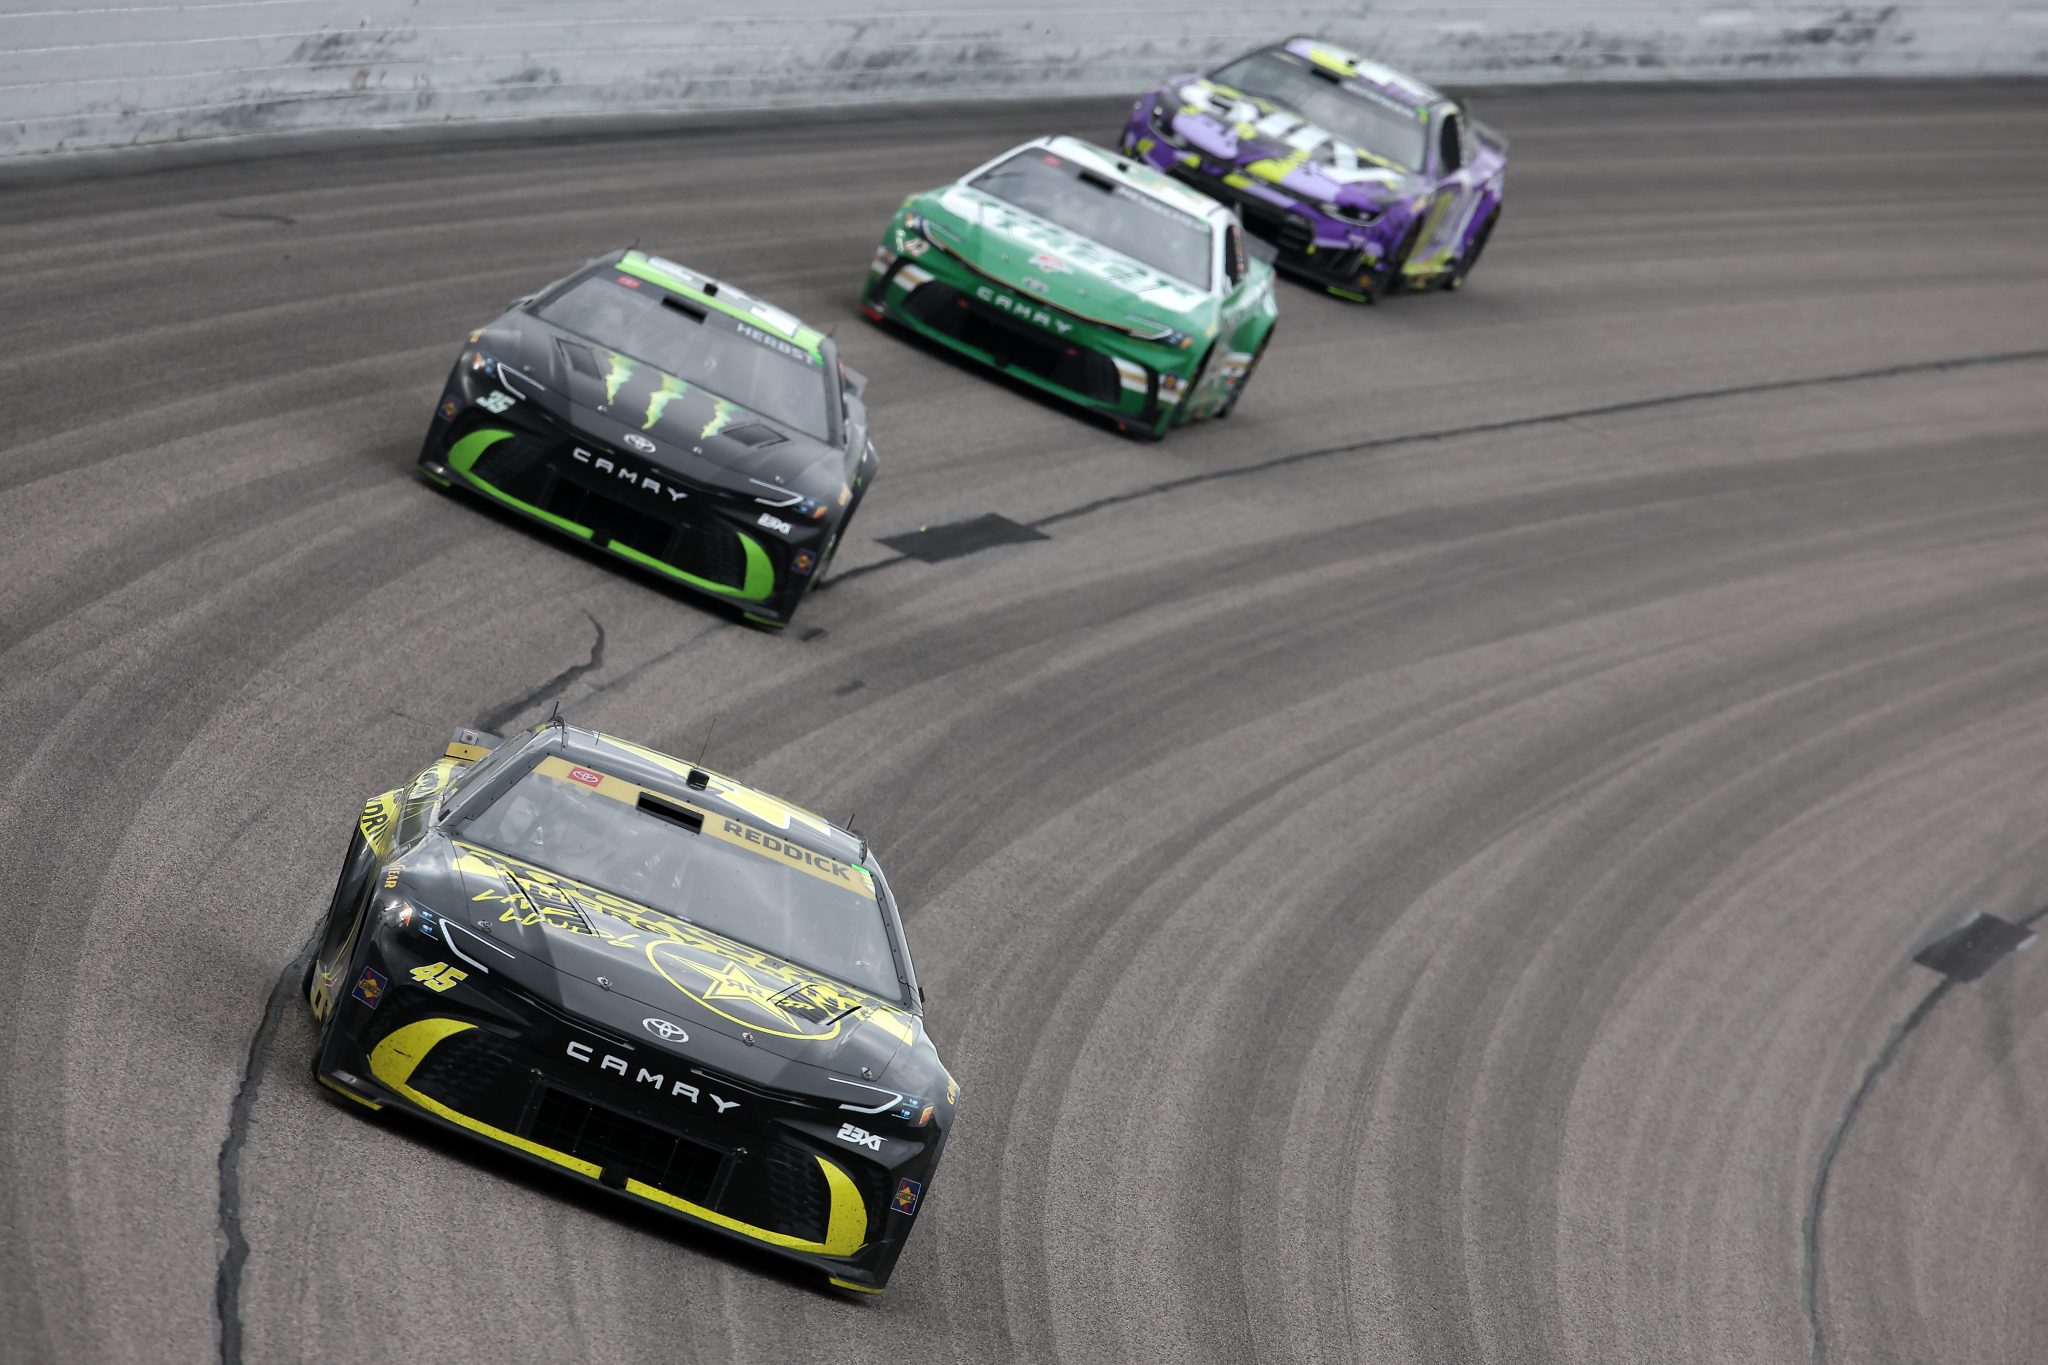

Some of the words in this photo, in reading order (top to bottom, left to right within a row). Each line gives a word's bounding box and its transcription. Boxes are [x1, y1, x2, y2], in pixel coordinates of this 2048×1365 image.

[976, 285, 1074, 336] CAMRY
[737, 322, 816, 366] HERBST
[572, 446, 690, 504] CAMRY
[723, 819, 852, 881] REDDICK
[409, 961, 469, 993] 45
[566, 1040, 741, 1114] CAMRY
